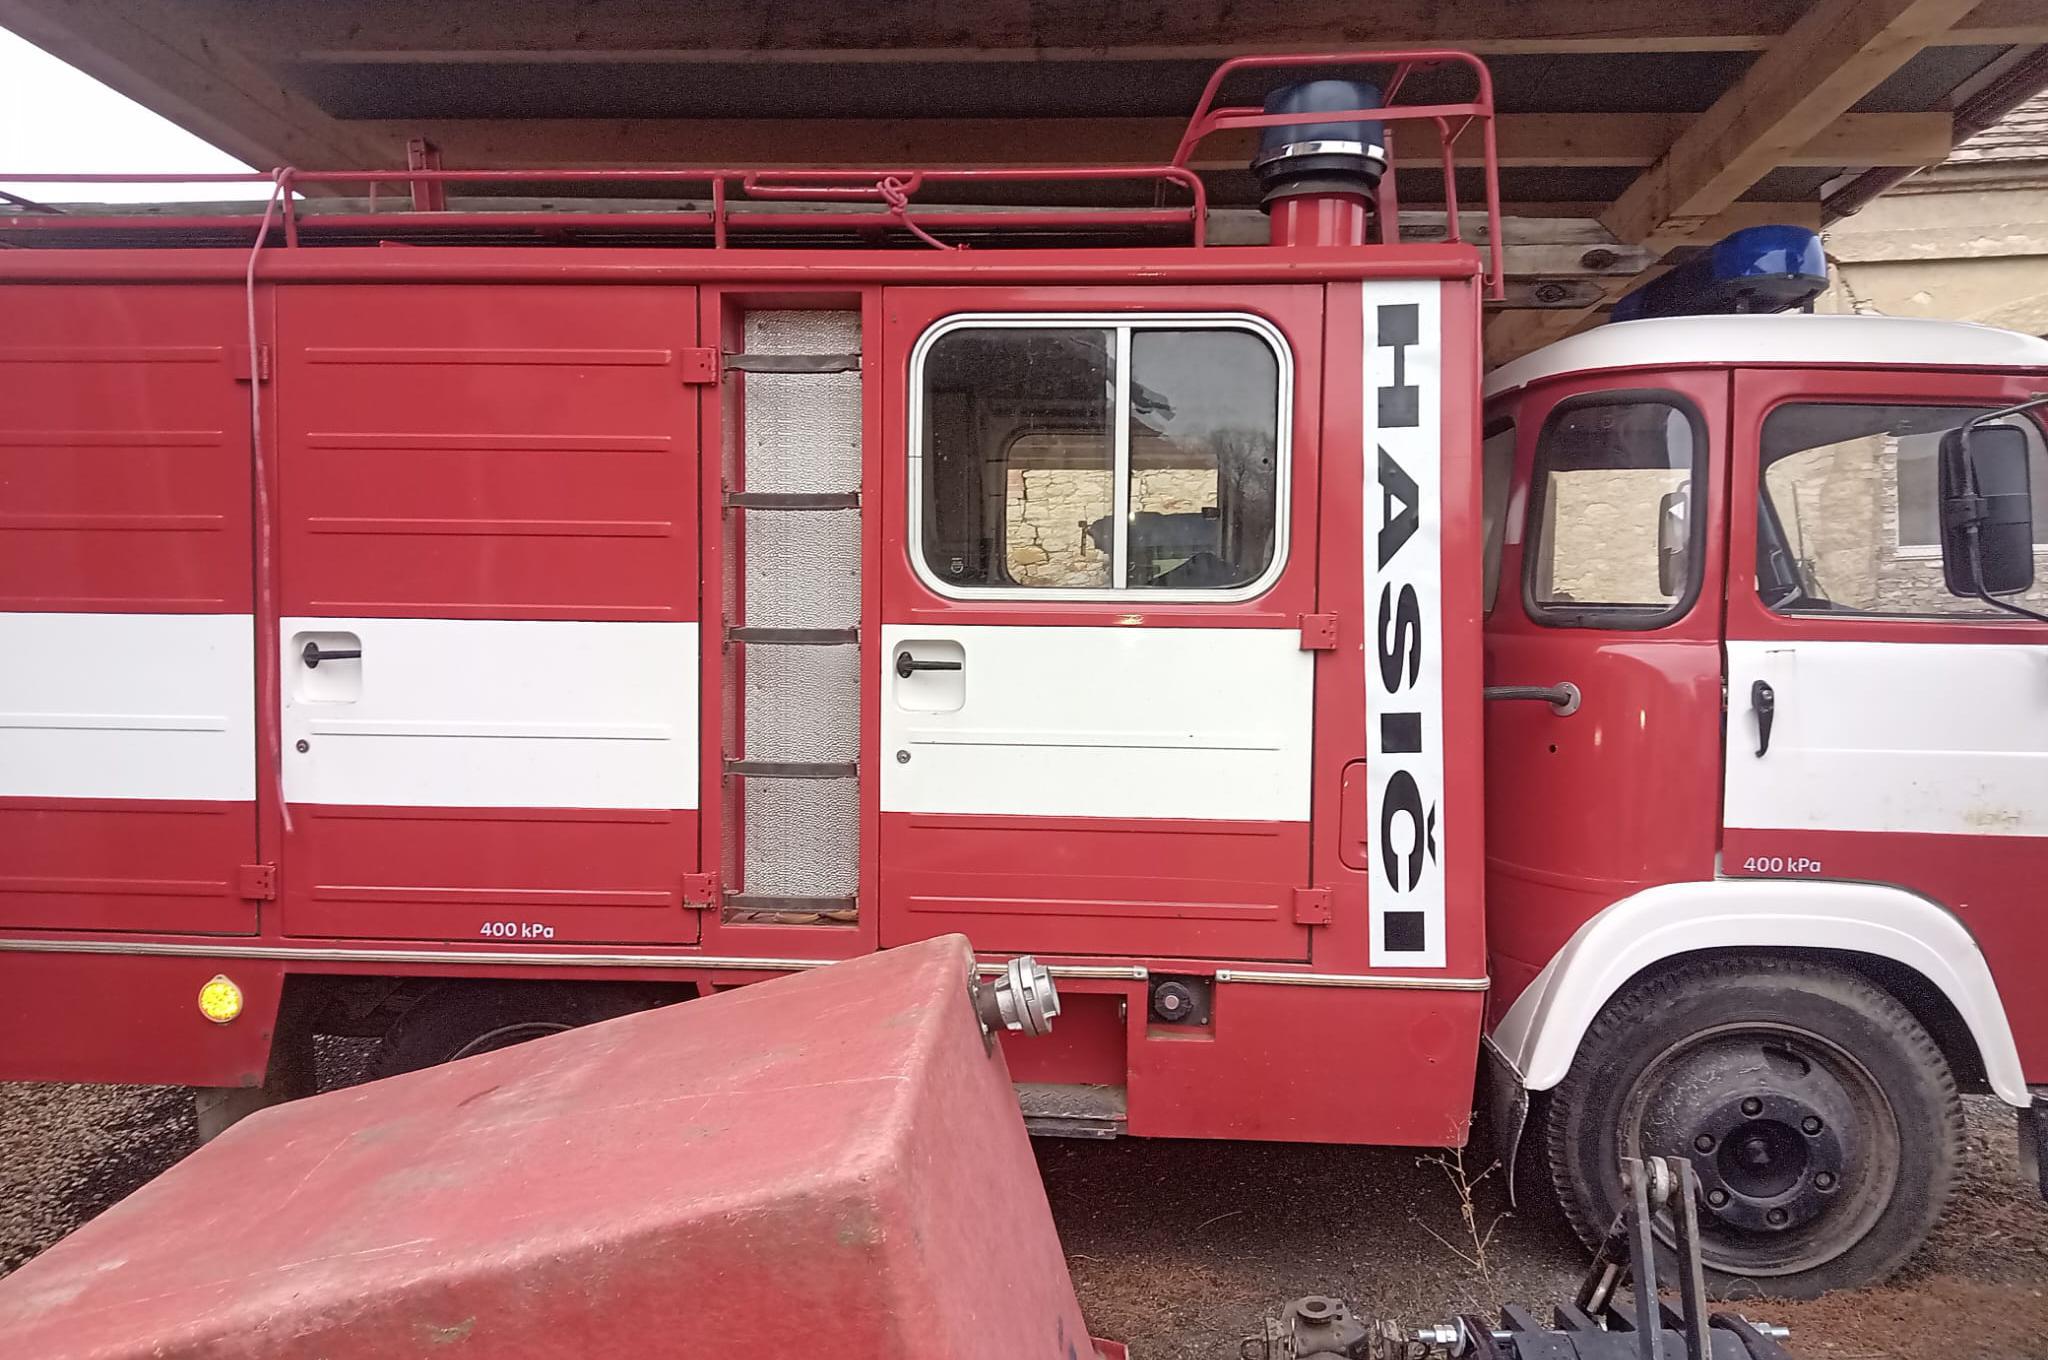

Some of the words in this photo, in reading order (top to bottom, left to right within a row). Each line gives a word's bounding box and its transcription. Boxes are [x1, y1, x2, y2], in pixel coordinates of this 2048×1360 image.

[1377, 303, 1437, 952] HASIČI
[1743, 857, 1784, 873] 400
[1787, 857, 1821, 873] kPa
[480, 922, 518, 937] 400
[521, 922, 554, 939] kPa
